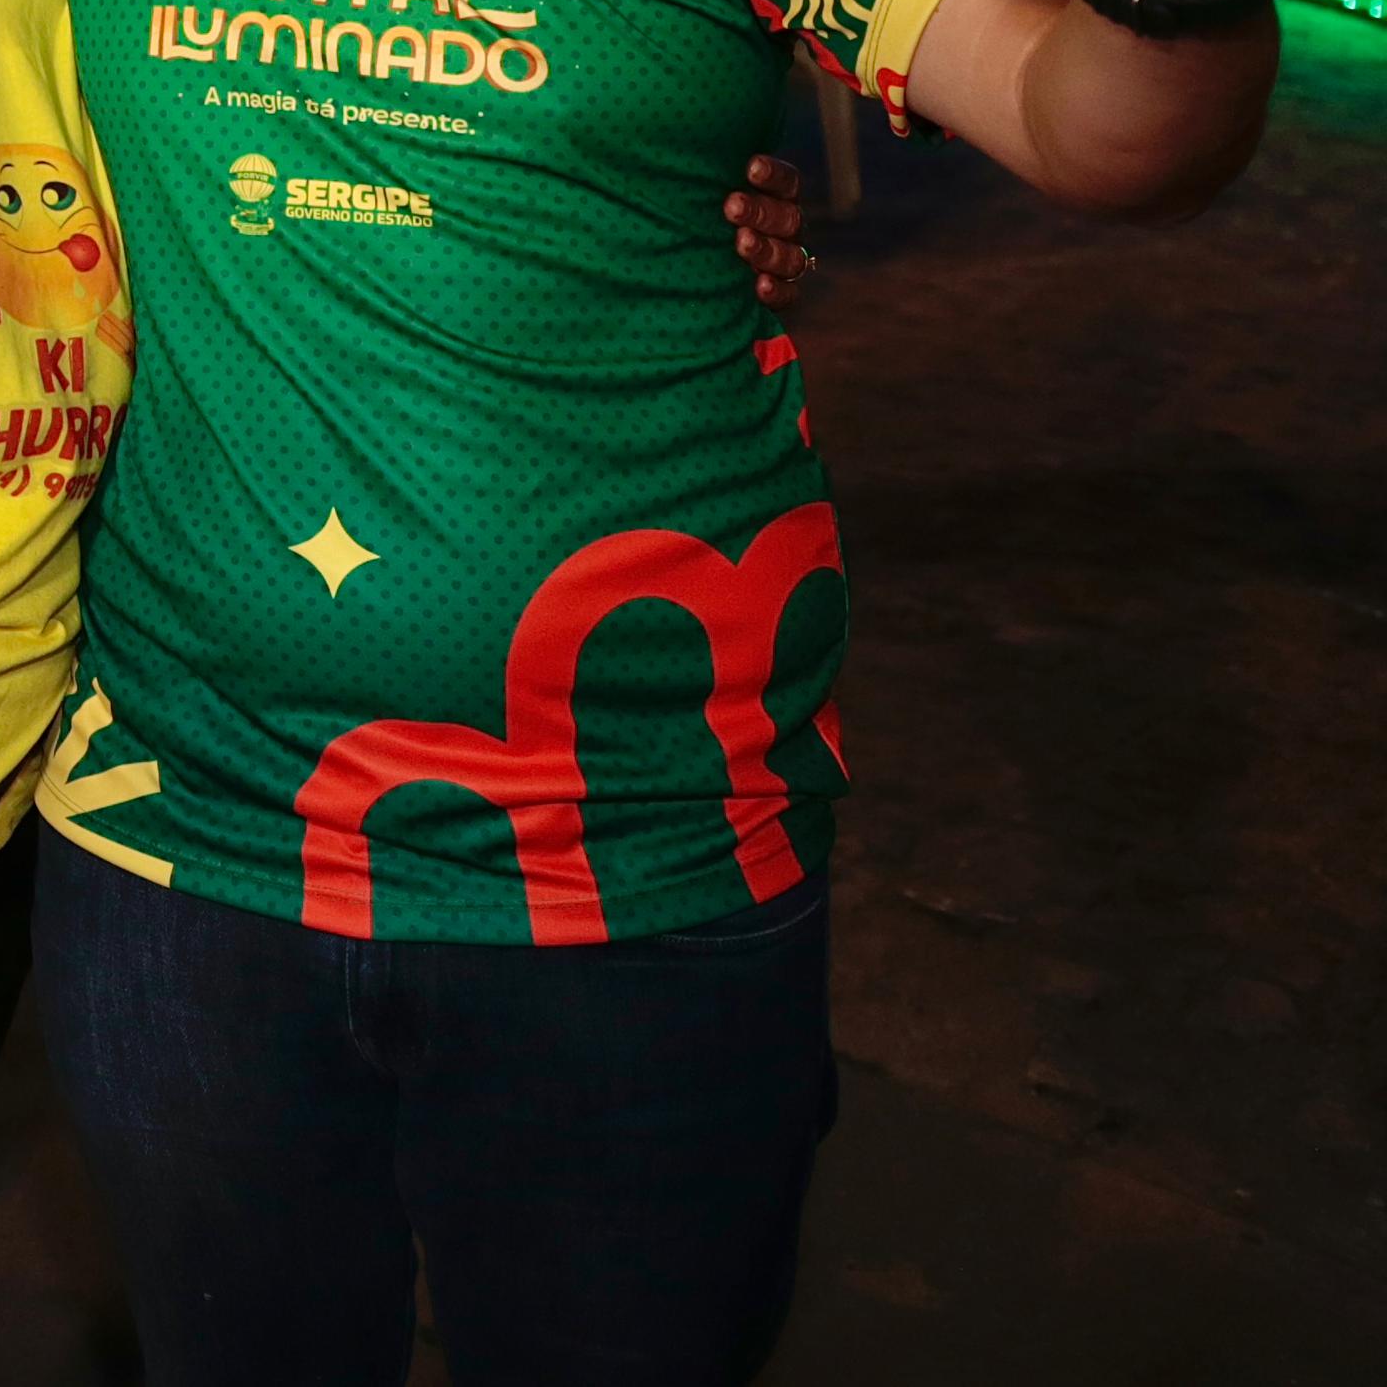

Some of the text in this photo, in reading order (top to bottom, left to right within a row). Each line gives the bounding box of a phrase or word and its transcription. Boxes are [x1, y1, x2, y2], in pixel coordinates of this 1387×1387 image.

[147, 3, 550, 94] ILUMINADO
[204, 86, 477, 137] A magia tá presente.
[285, 178, 434, 216] SERGIPE
[285, 205, 434, 228] GOVERNO DO ESTADO
[35, 336, 86, 394] KI
